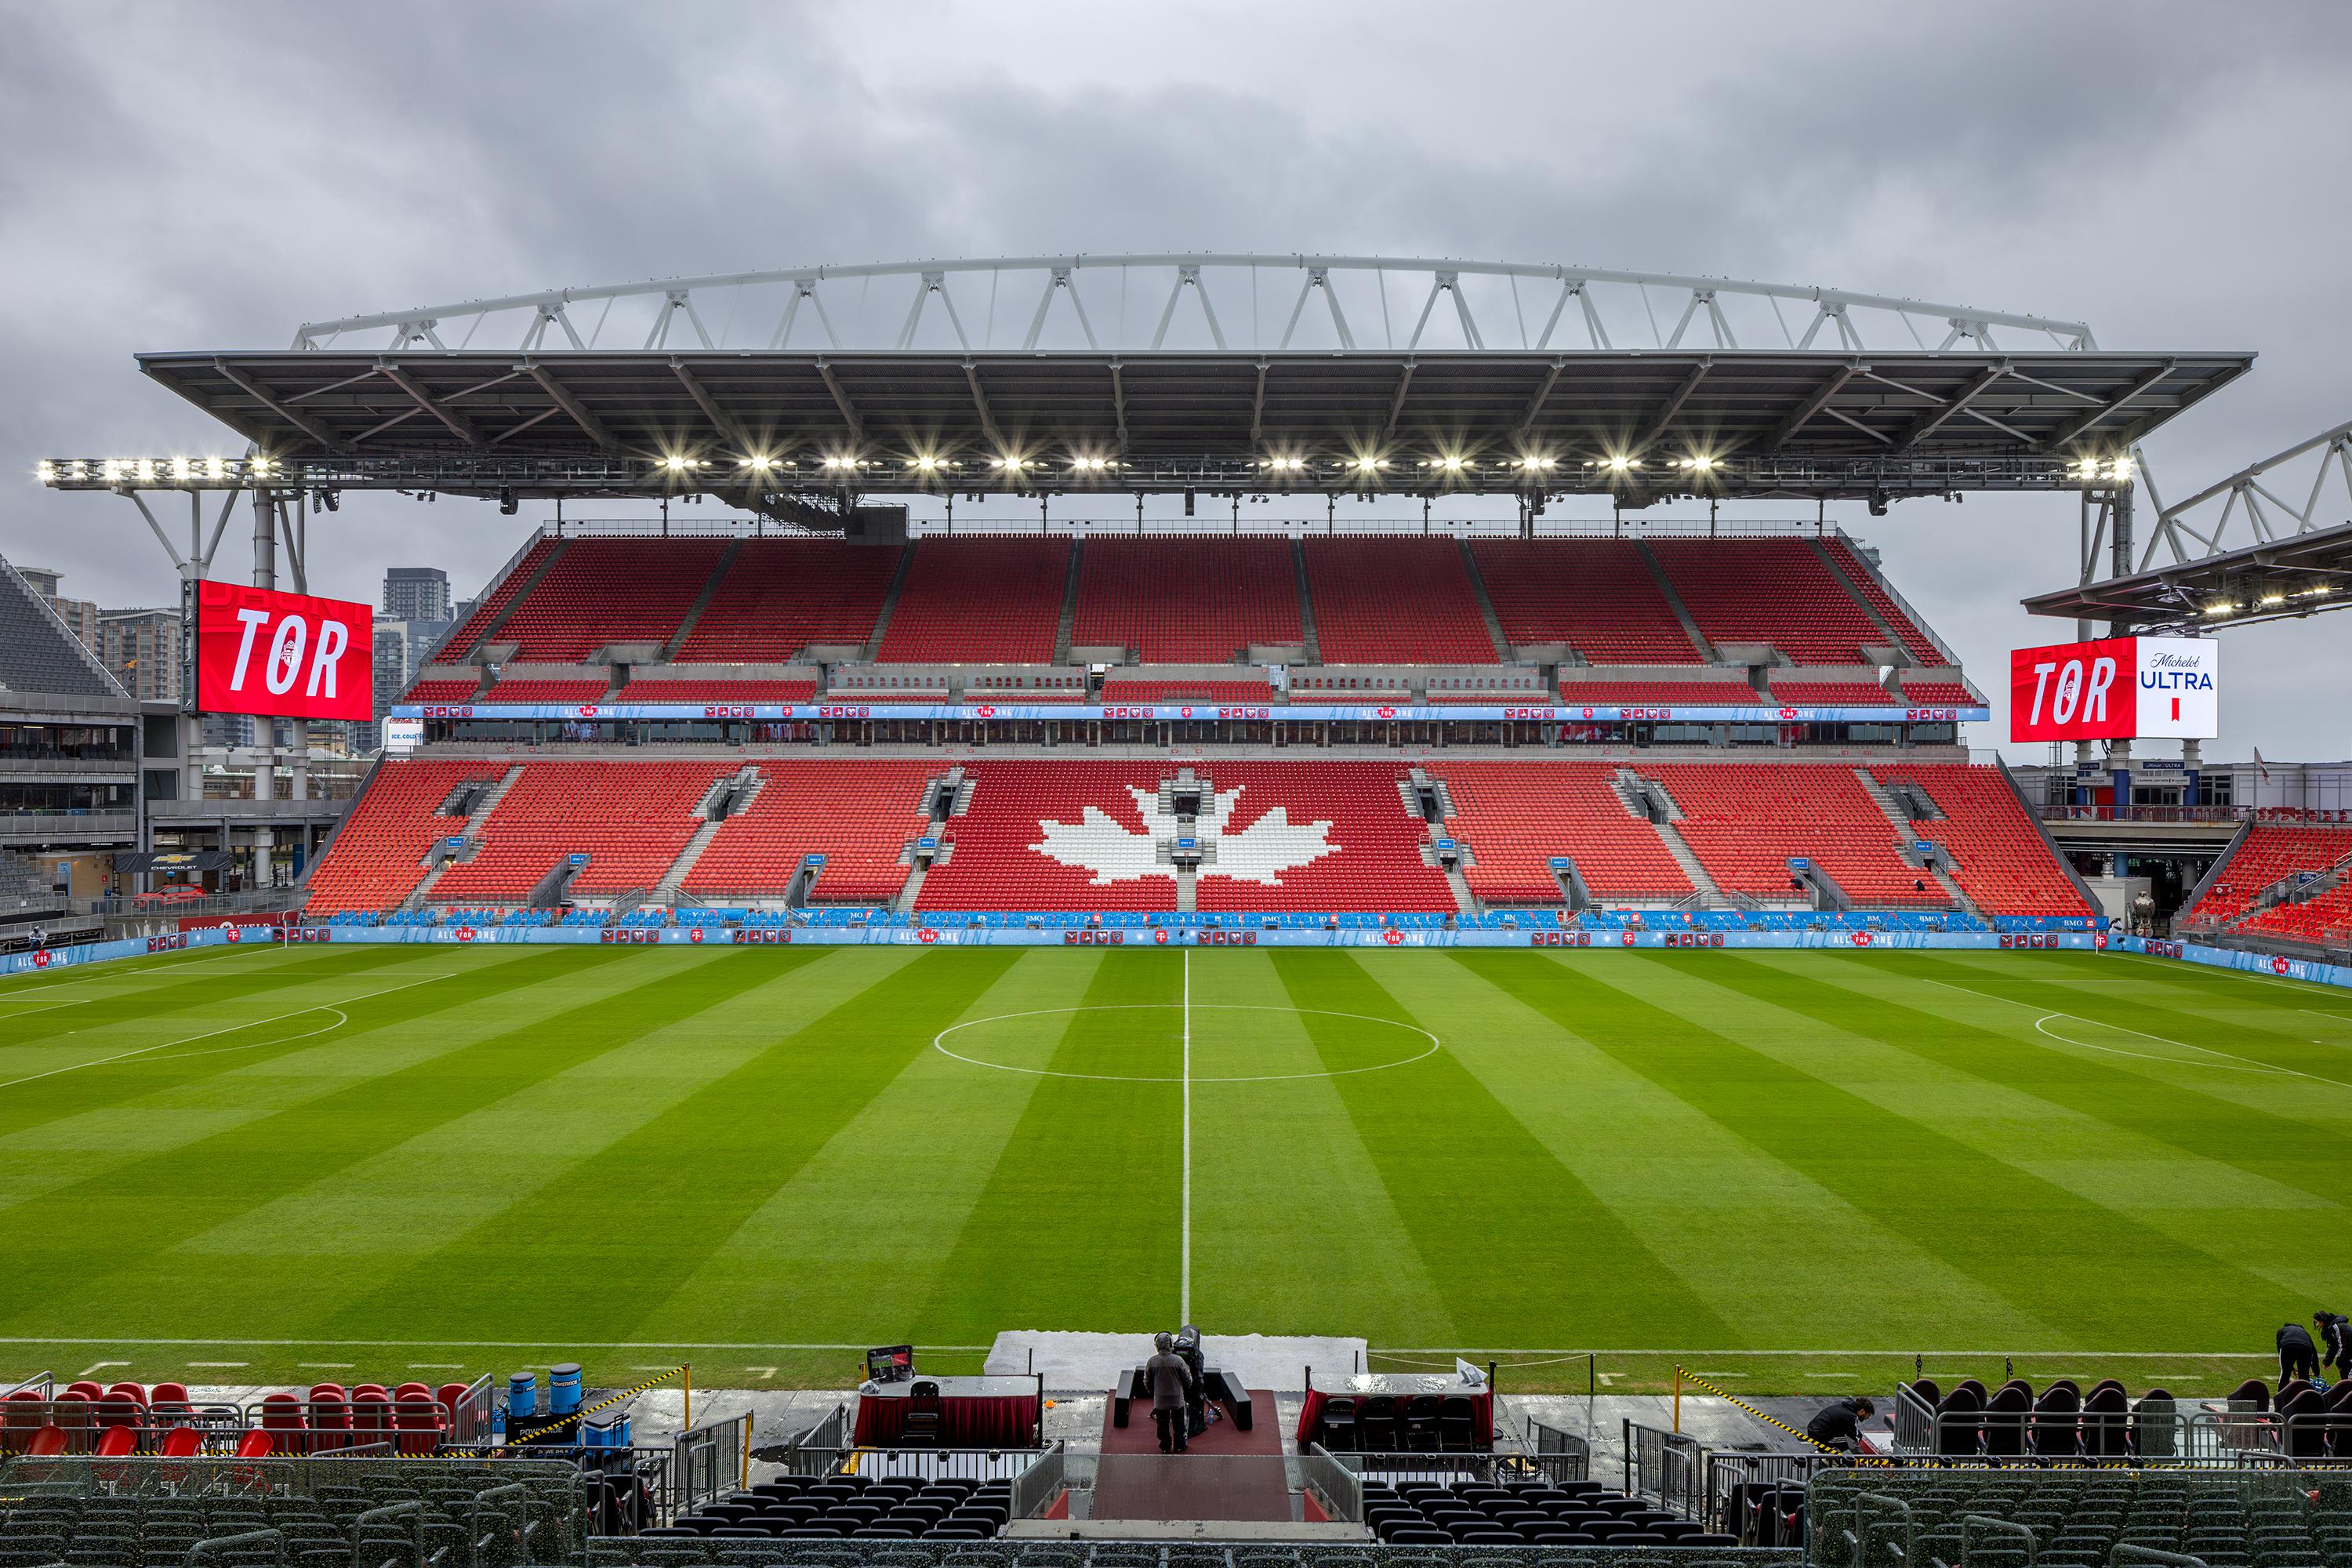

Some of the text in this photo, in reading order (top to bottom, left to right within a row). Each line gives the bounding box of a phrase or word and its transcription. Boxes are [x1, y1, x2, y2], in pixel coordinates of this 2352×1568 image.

[230, 608, 349, 699] TOR
[2150, 652, 2201, 668] Michelob
[2140, 671, 2213, 690] ULTRA
[2030, 657, 2116, 726] TOR
[900, 932, 916, 941] ALL
[940, 932, 958, 941] ONE
[1366, 934, 1381, 942] ALL
[1406, 934, 1424, 942] ONE
[1834, 935, 1849, 944] ALL
[1874, 935, 1892, 944] ONE
[17, 956, 32, 967] ALL
[52, 952, 67, 962] ONE
[2259, 959, 2271, 970] ALL
[2290, 964, 2305, 975] ONE
